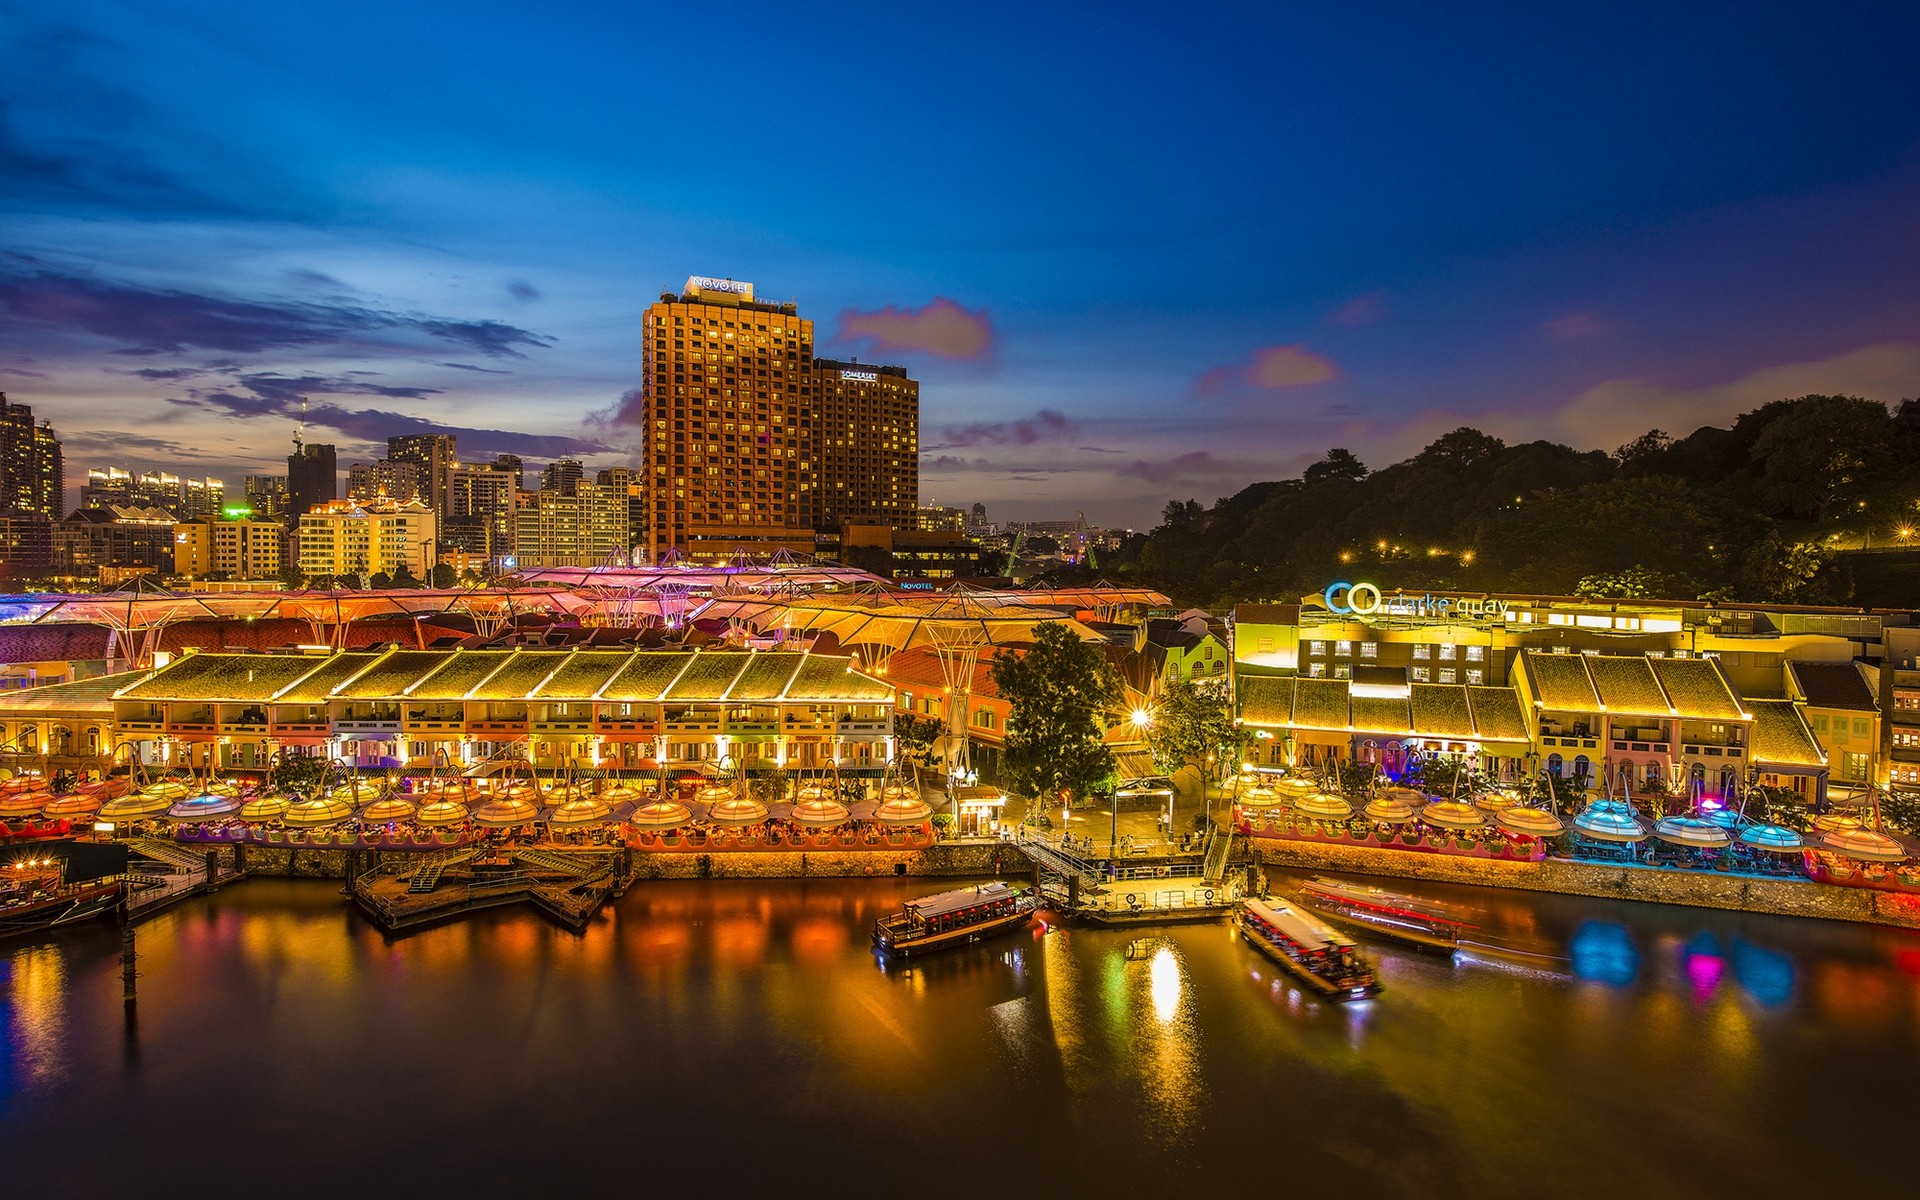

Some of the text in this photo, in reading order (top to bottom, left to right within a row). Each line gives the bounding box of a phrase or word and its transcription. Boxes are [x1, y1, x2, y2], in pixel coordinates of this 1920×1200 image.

[693, 276, 749, 293] NOVOTEL
[900, 582, 934, 590] NOVOTEL
[1388, 593, 1450, 613] clarke
[1457, 598, 1510, 618] quay
